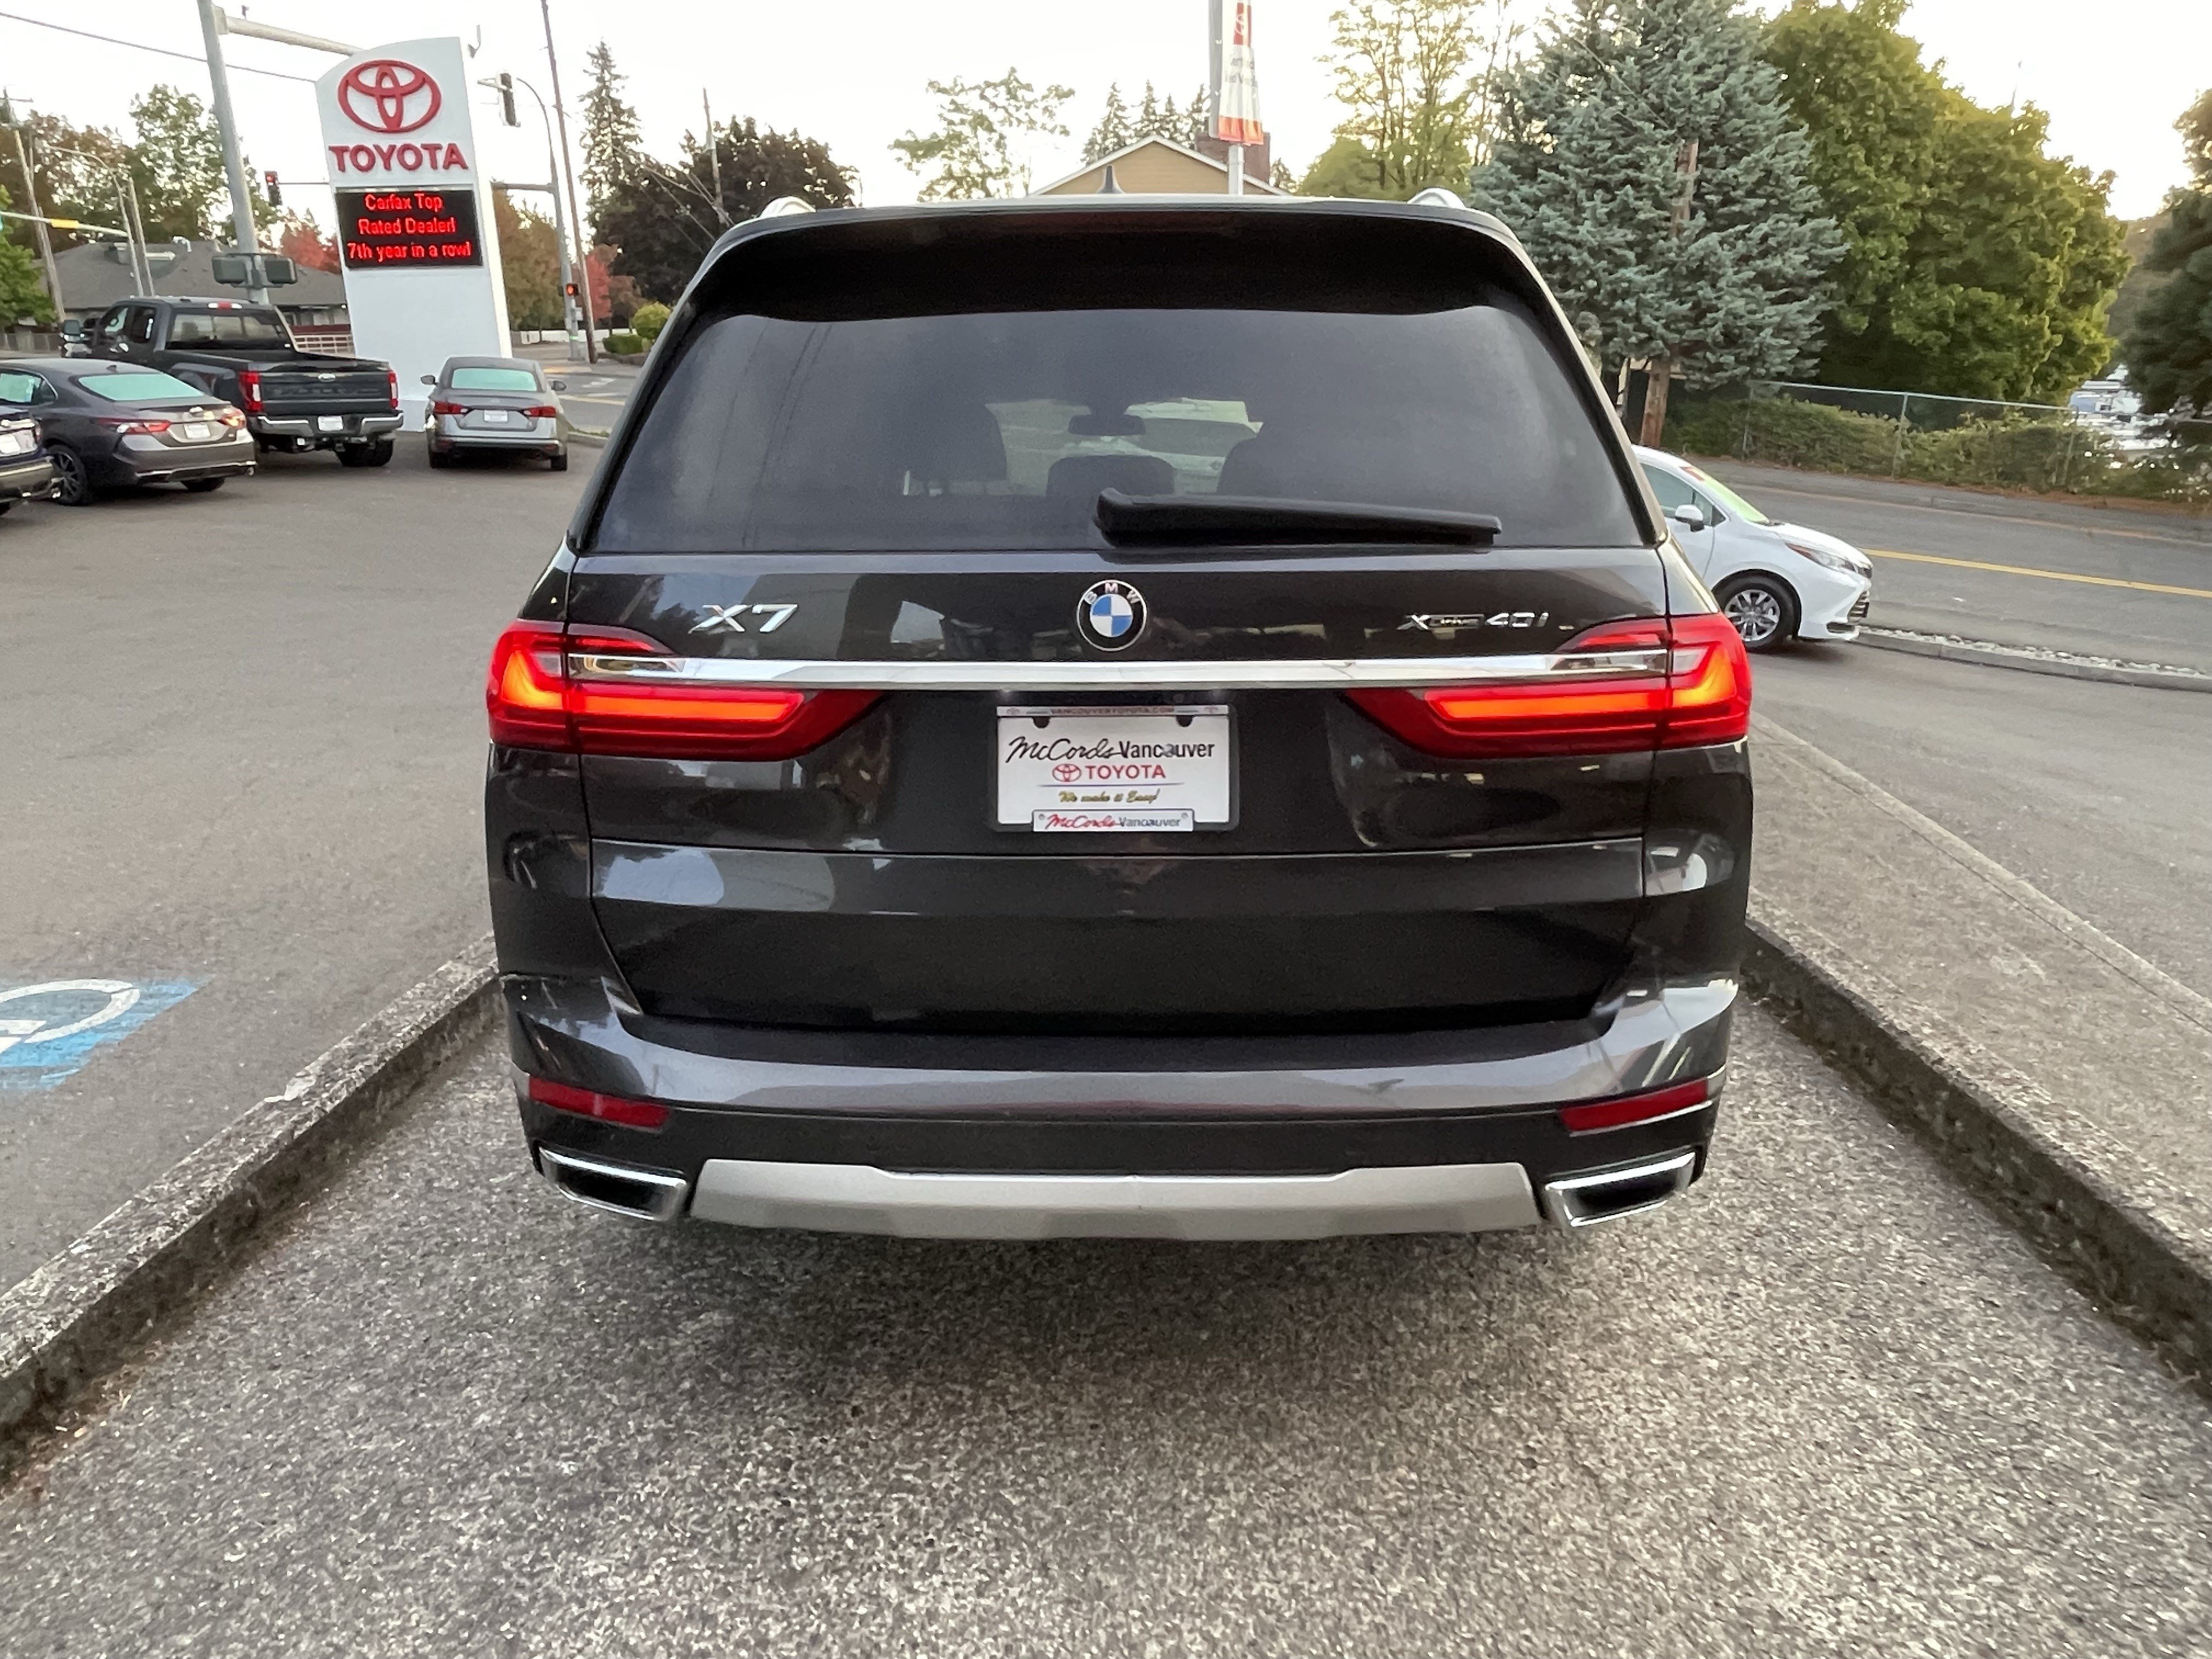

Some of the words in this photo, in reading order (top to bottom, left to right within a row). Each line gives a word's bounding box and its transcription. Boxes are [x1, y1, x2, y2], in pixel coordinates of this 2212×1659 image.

[329, 143, 468, 172] TOYOTA
[364, 193, 413, 211] Carfax
[414, 193, 444, 213] Top
[358, 218, 402, 235] Rated
[404, 216, 457, 235] Dealer!
[347, 242, 374, 259] 7th
[376, 245, 408, 263] year
[411, 241, 425, 258] in
[428, 245, 439, 258] a
[442, 240, 472, 257] row!
[688, 604, 799, 634] X7
[1085, 764, 1167, 780] TOYOTA
